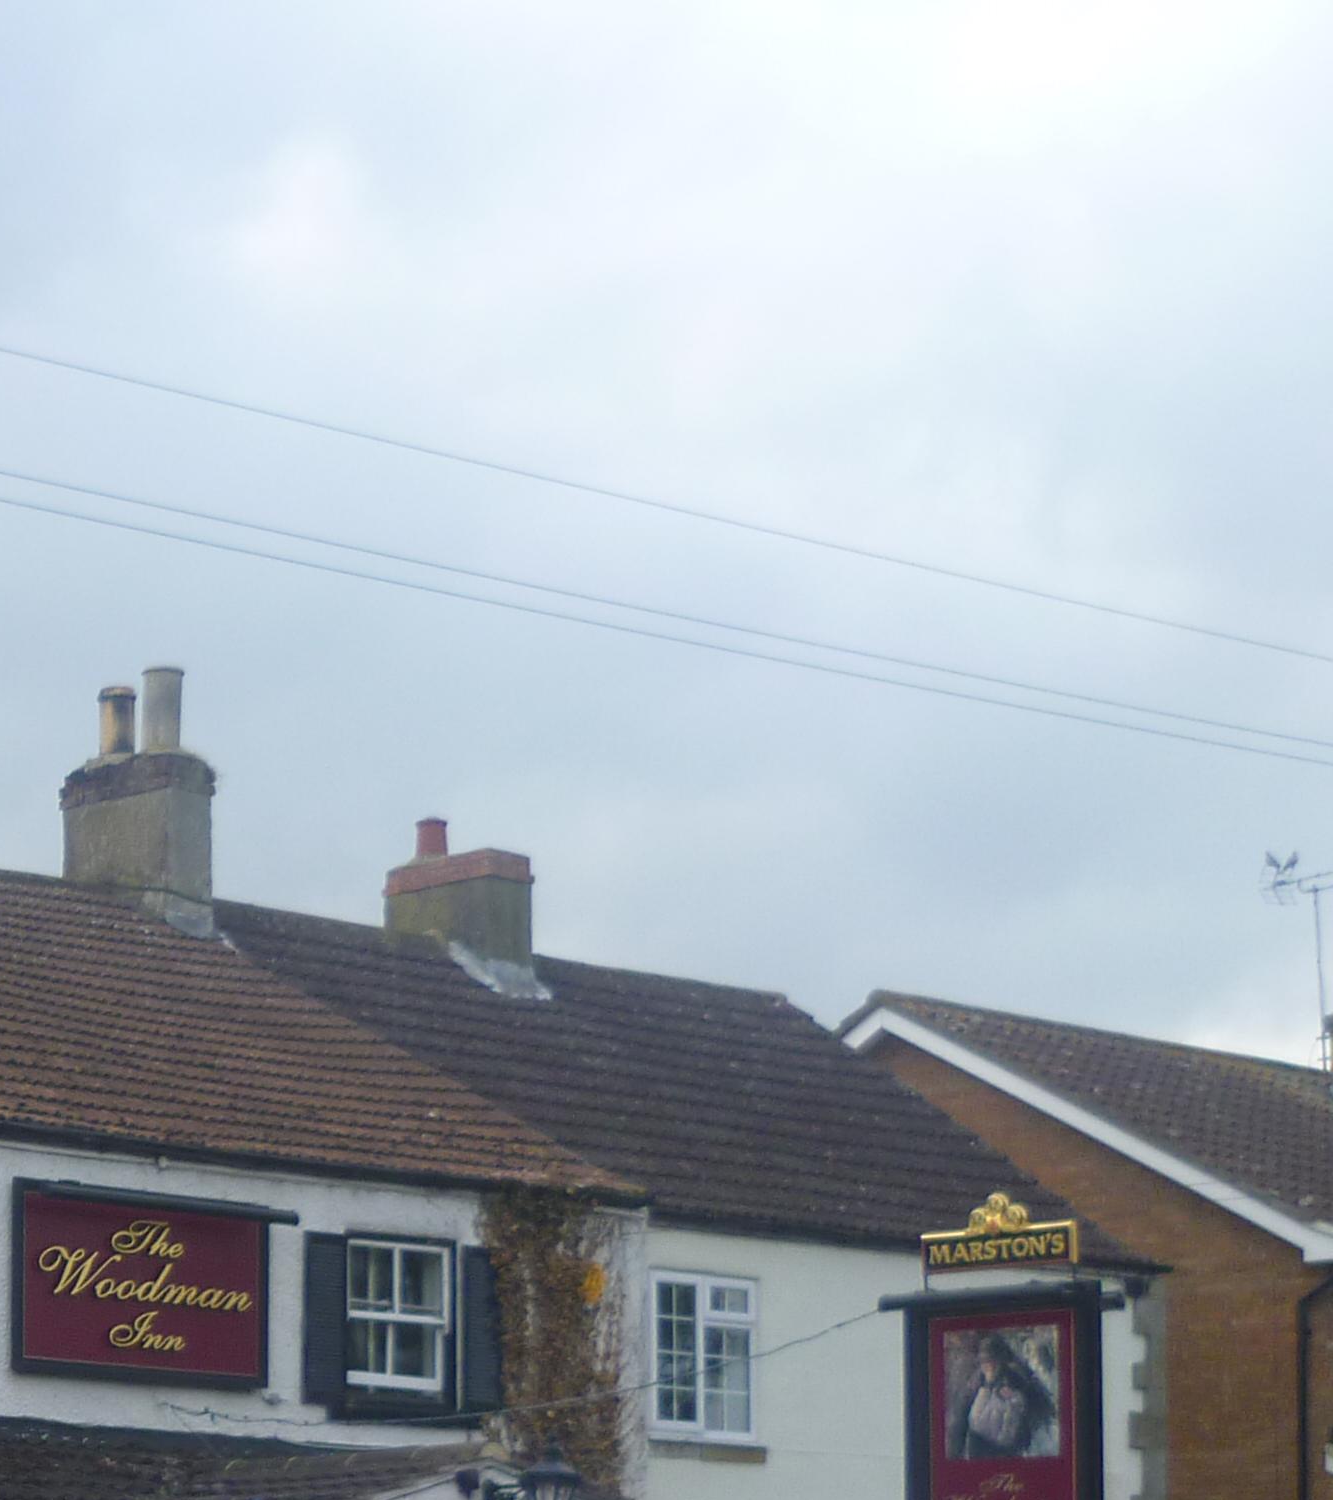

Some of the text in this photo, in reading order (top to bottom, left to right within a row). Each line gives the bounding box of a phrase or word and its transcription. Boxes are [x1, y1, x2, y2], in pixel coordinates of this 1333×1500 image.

[110, 1219, 185, 1260] The
[929, 1232, 1066, 1266] MARSTON'S
[37, 1244, 254, 1313] Woodman
[108, 1310, 186, 1352] Inn
[978, 1472, 1026, 1492] The
